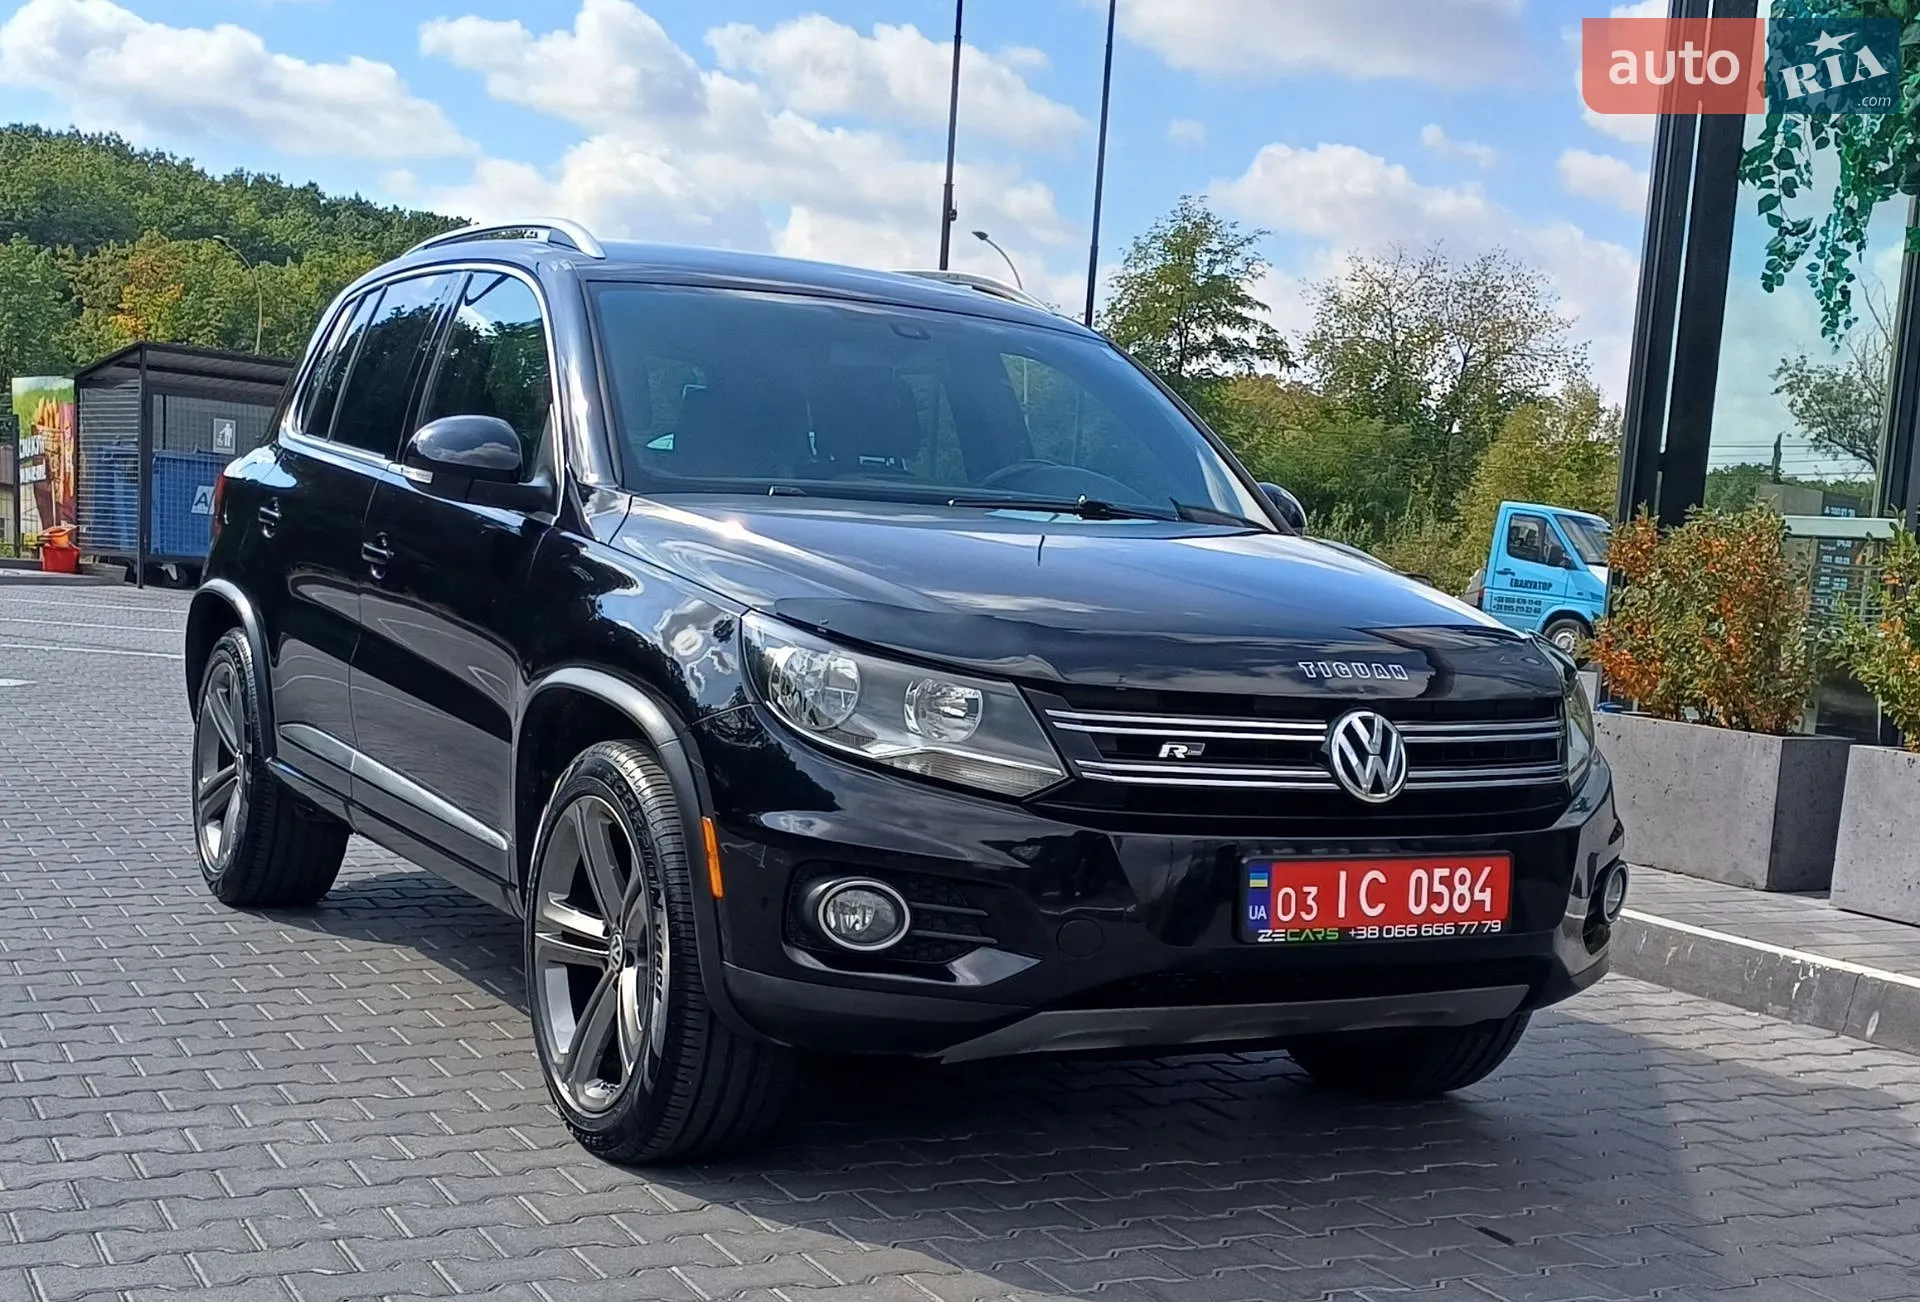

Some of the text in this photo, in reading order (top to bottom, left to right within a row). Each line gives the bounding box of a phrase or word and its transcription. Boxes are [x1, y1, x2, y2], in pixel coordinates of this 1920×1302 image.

[1298, 661, 1408, 680] TIGUAN
[1276, 866, 1493, 922] 03 IC 0584
[1249, 905, 1267, 920] UA
[1257, 919, 1502, 943] ZECARS +38 066 666 77 79
